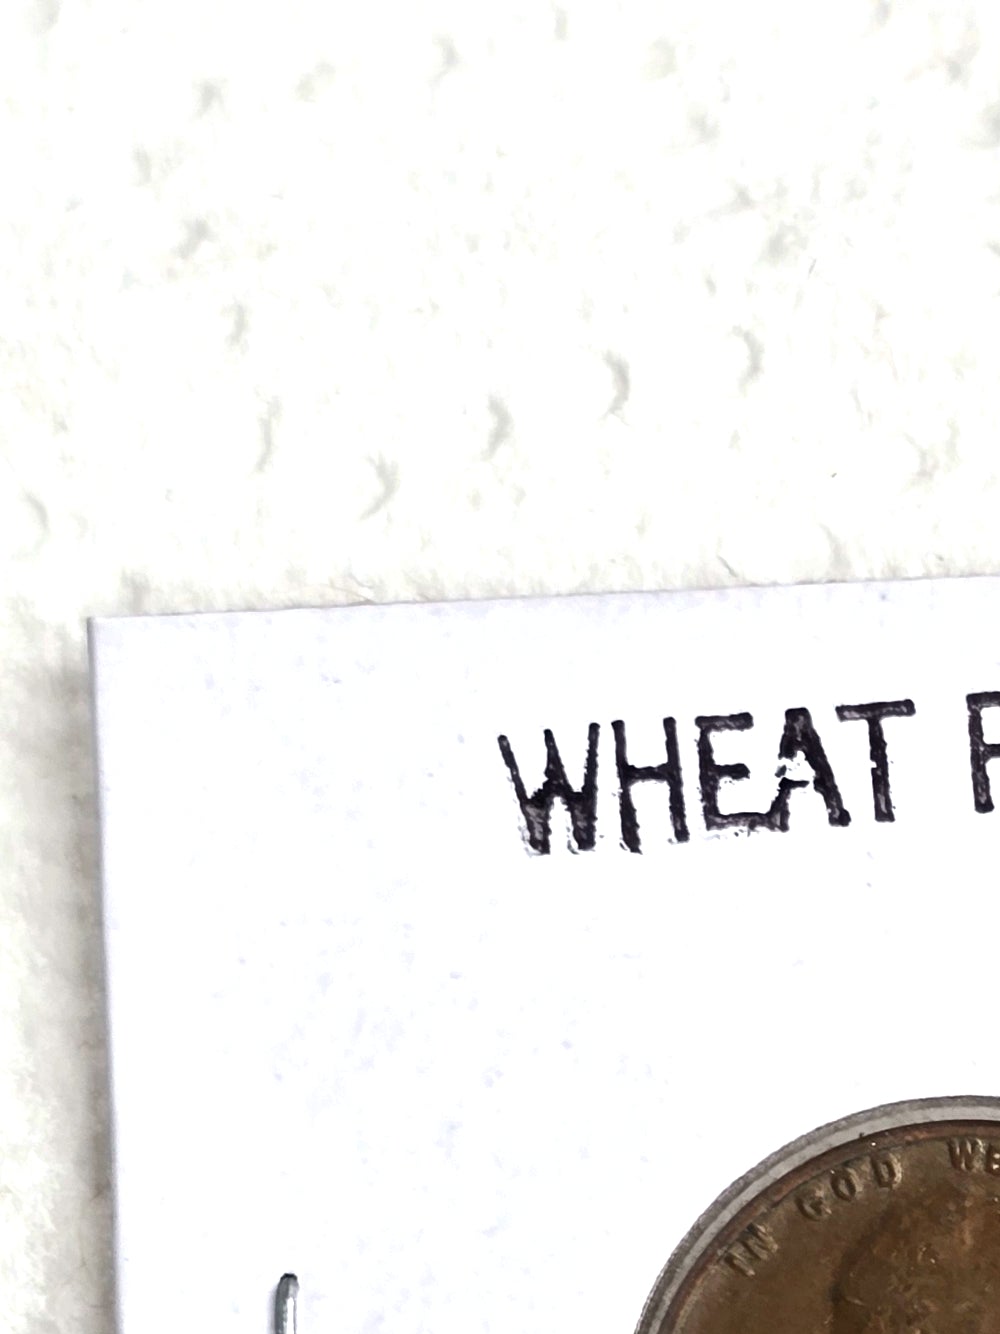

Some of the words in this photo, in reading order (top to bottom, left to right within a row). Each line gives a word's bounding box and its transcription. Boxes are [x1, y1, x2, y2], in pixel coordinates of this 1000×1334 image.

[497, 699, 917, 855] WHEAT
[723, 1223, 778, 1279] IN
[798, 1150, 904, 1222] GOD
